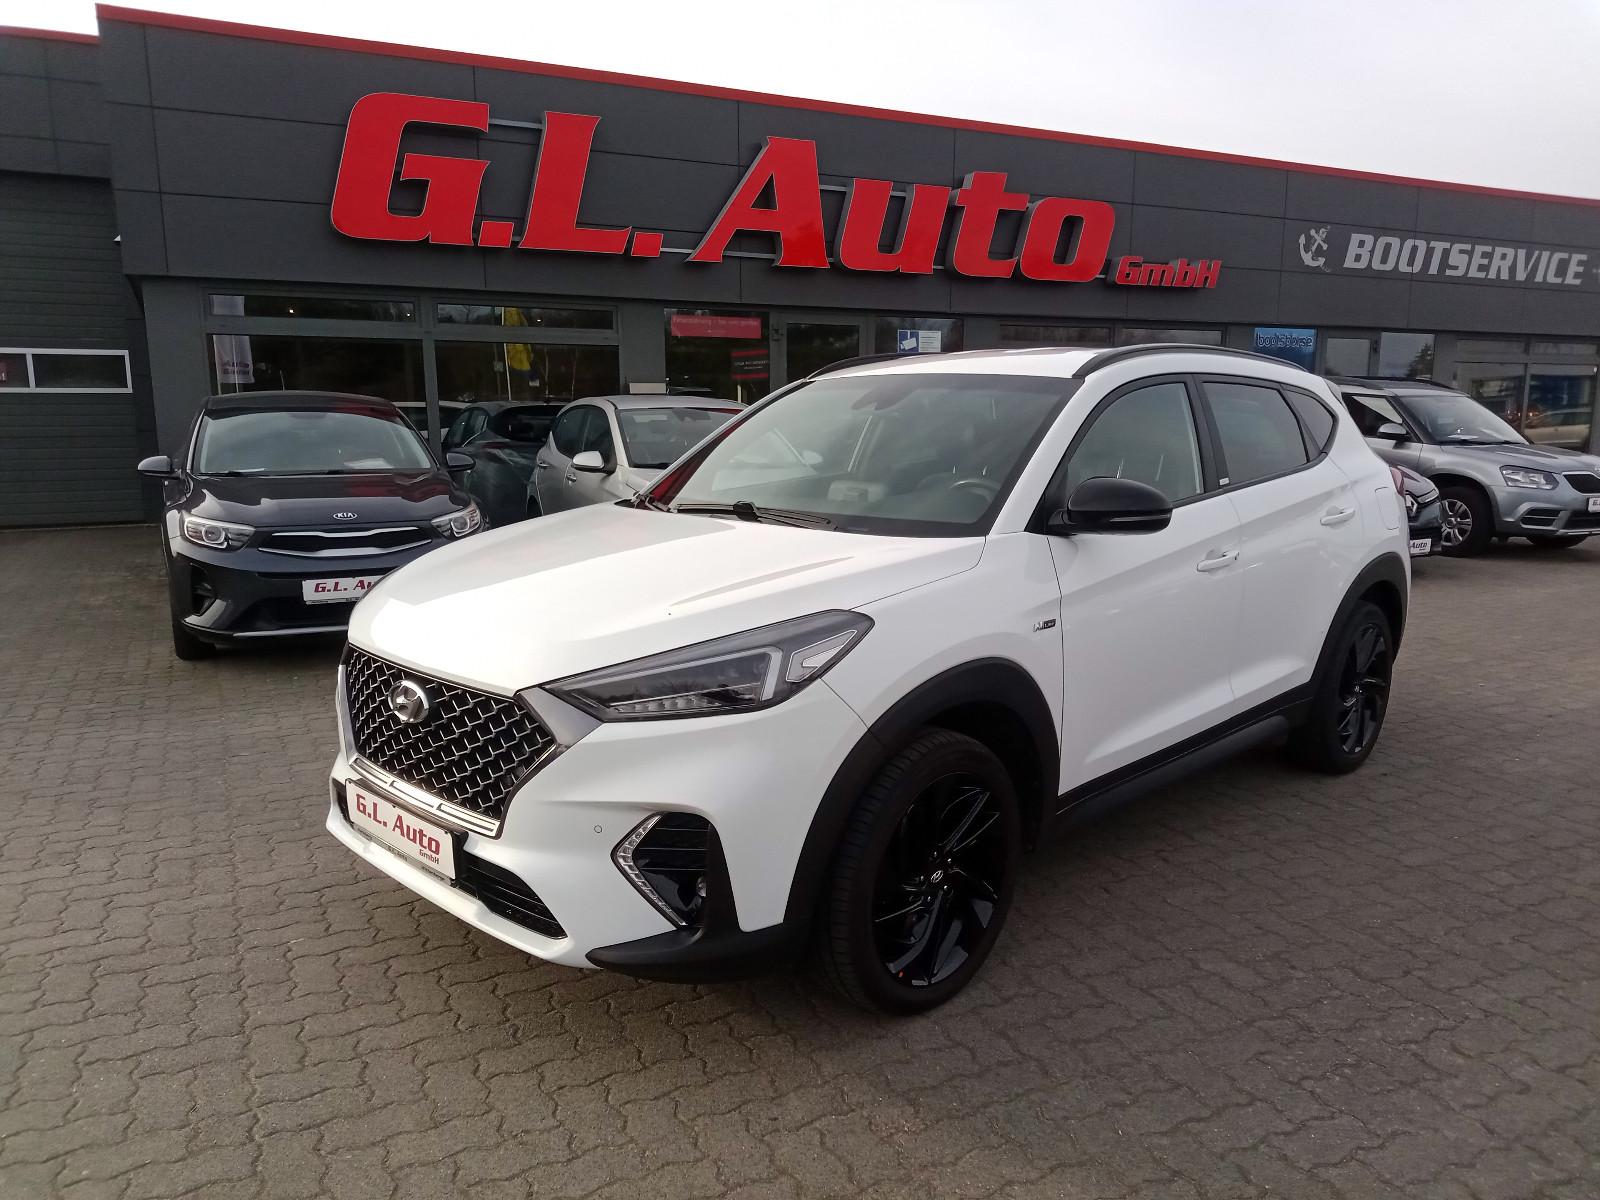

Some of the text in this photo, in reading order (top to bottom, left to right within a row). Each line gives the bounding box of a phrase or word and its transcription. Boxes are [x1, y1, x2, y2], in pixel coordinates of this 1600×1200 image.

[331, 92, 1115, 282] G.L. Auto
[1114, 255, 1222, 289] GmbH
[1343, 233, 1588, 286] BOOTSERVICE
[314, 582, 348, 593] G.L.
[356, 793, 388, 828] G.L.
[392, 814, 441, 856] Auto
[419, 848, 440, 864] GmbH
